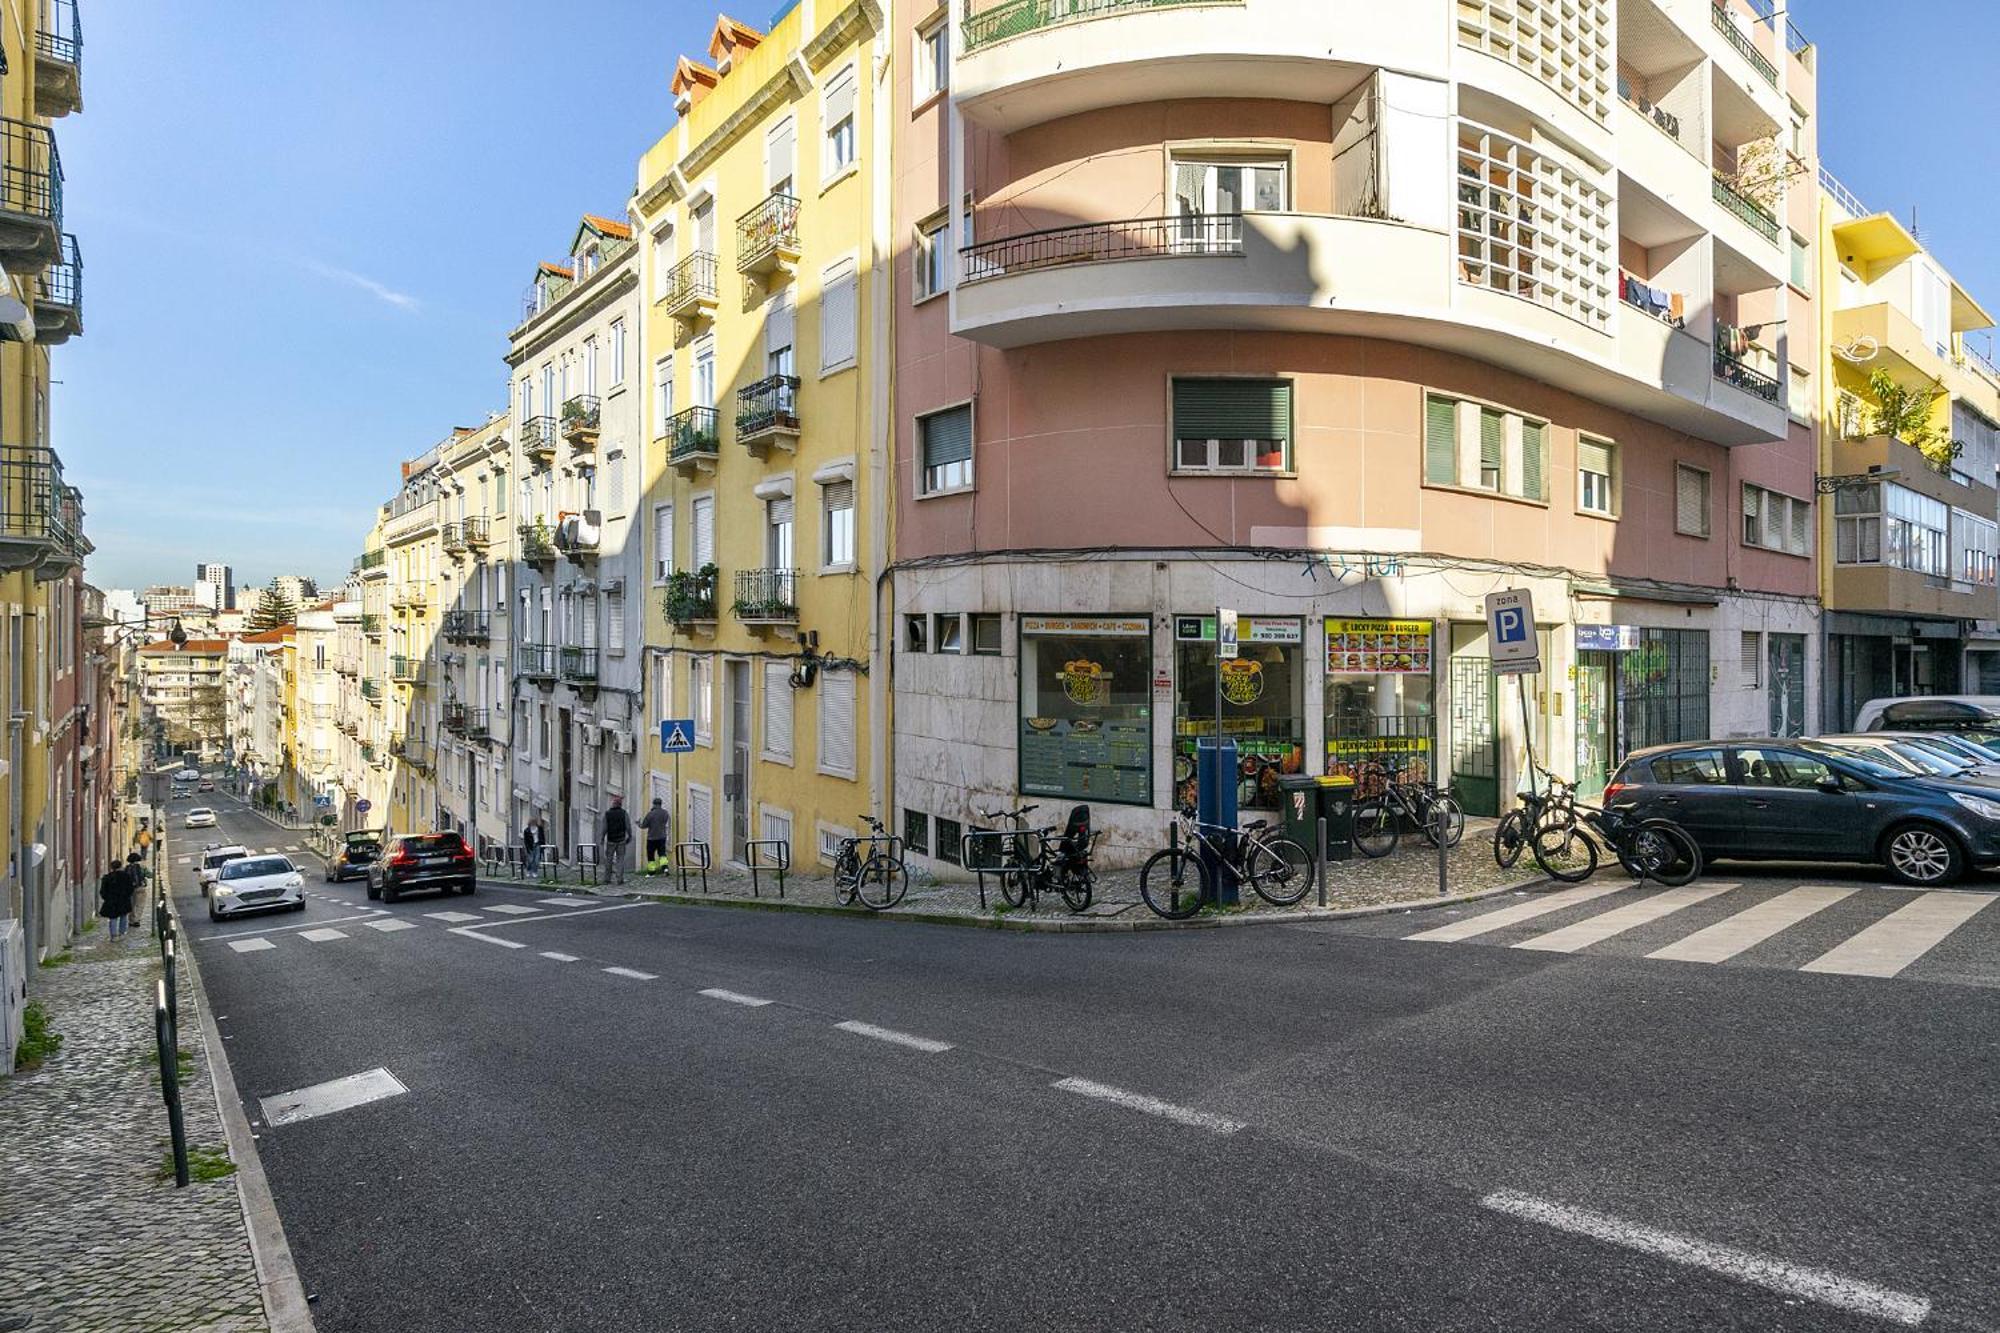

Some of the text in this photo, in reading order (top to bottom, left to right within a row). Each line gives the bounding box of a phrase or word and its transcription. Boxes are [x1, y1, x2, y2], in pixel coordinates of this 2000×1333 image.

[1496, 595, 1519, 606] zona
[1350, 623, 1370, 632] LUCKY
[1371, 624, 1389, 632] PIZZA
[1395, 624, 1420, 633] BURGER
[1500, 610, 1519, 641] P
